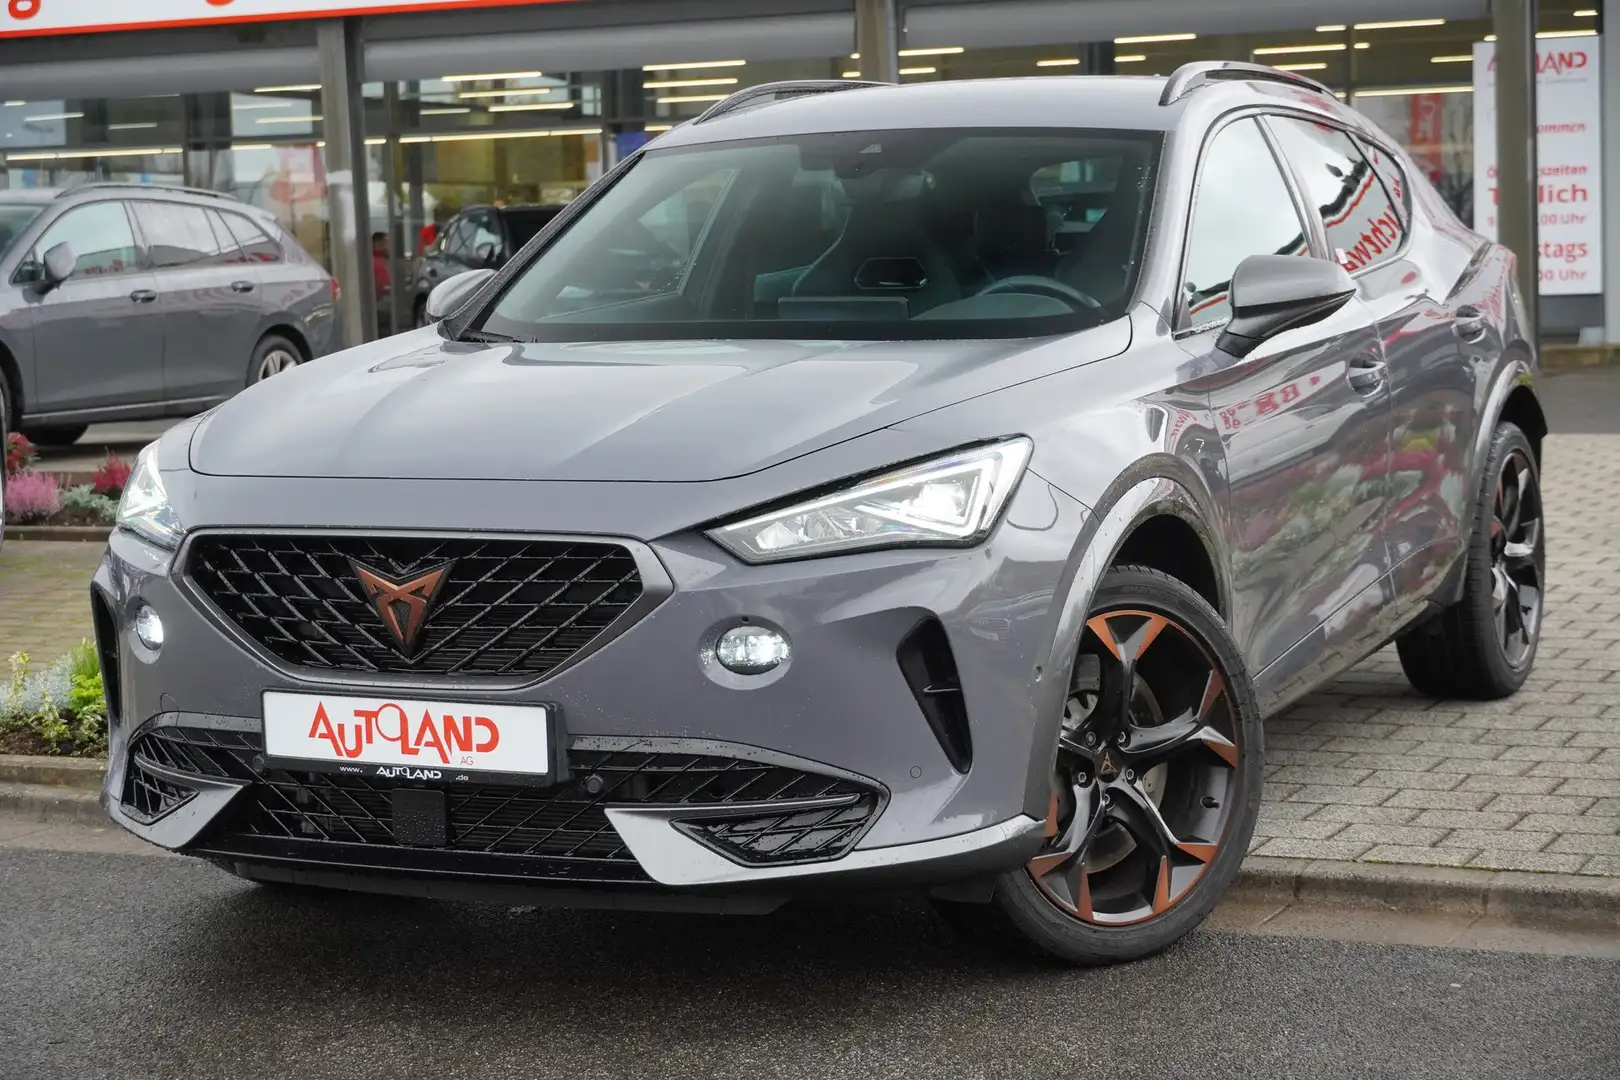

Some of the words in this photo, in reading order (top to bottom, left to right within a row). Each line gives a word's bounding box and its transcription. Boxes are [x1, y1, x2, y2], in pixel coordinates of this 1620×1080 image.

[1560, 212, 1586, 225] Uhr
[1558, 268, 1587, 281] Uhr
[308, 701, 500, 765] AUTOLAND
[460, 755, 475, 767] AG
[376, 766, 442, 781] AUTOLAND
